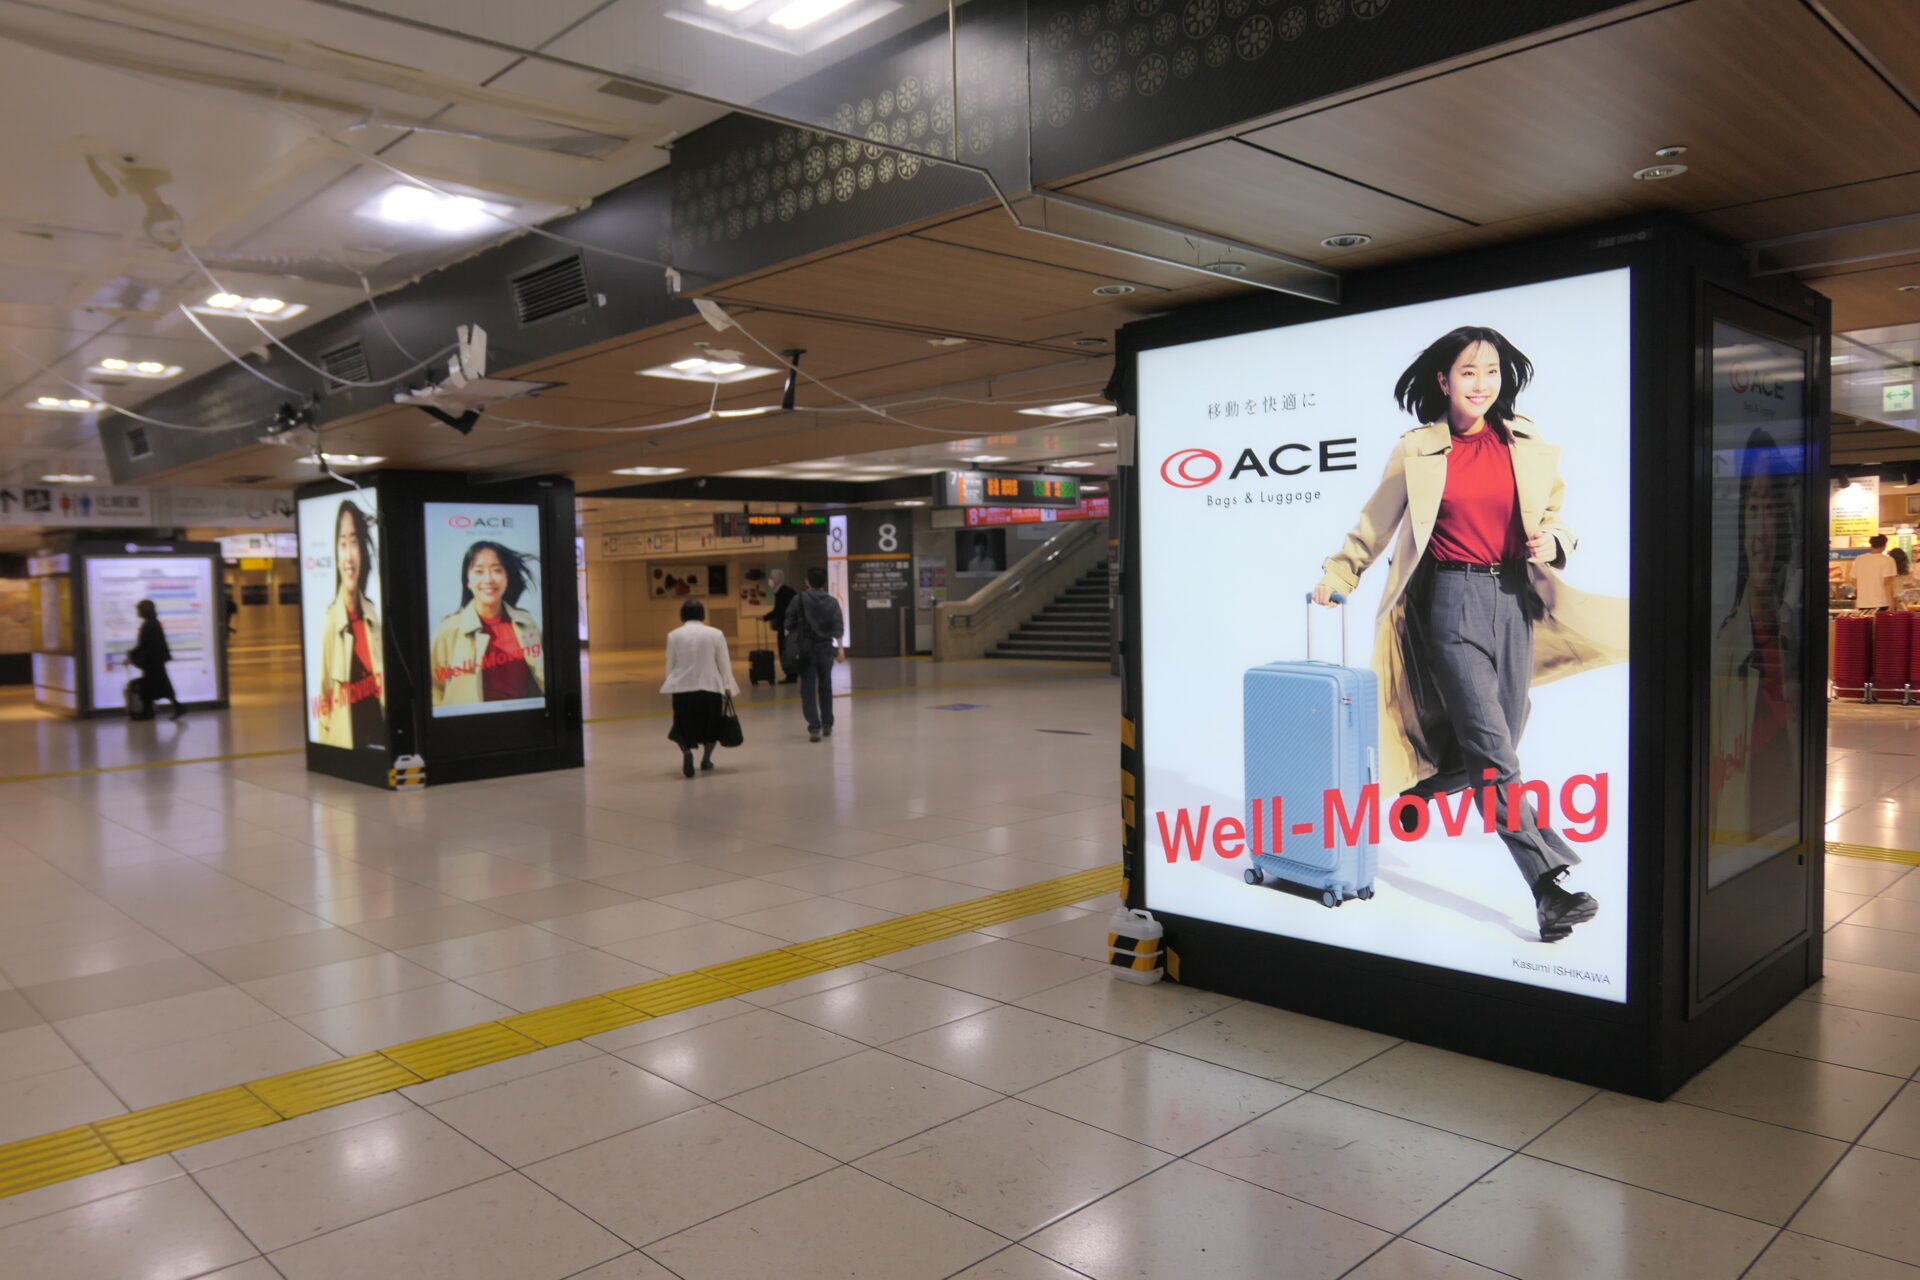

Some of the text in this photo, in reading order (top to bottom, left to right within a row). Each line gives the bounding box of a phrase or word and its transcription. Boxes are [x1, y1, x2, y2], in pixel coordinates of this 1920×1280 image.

[1207, 392, 1318, 420] 移動を快適に
[1228, 437, 1358, 480] ACE
[1207, 490, 1321, 508] Bags & Luggage
[473, 517, 514, 529] ACE
[832, 526, 843, 553] 8
[878, 523, 898, 552] 8
[434, 643, 542, 682] Well-Moving
[1155, 767, 1610, 864] Well-Moving
[1512, 958, 1611, 984] Kasumi ISHIKAWA
